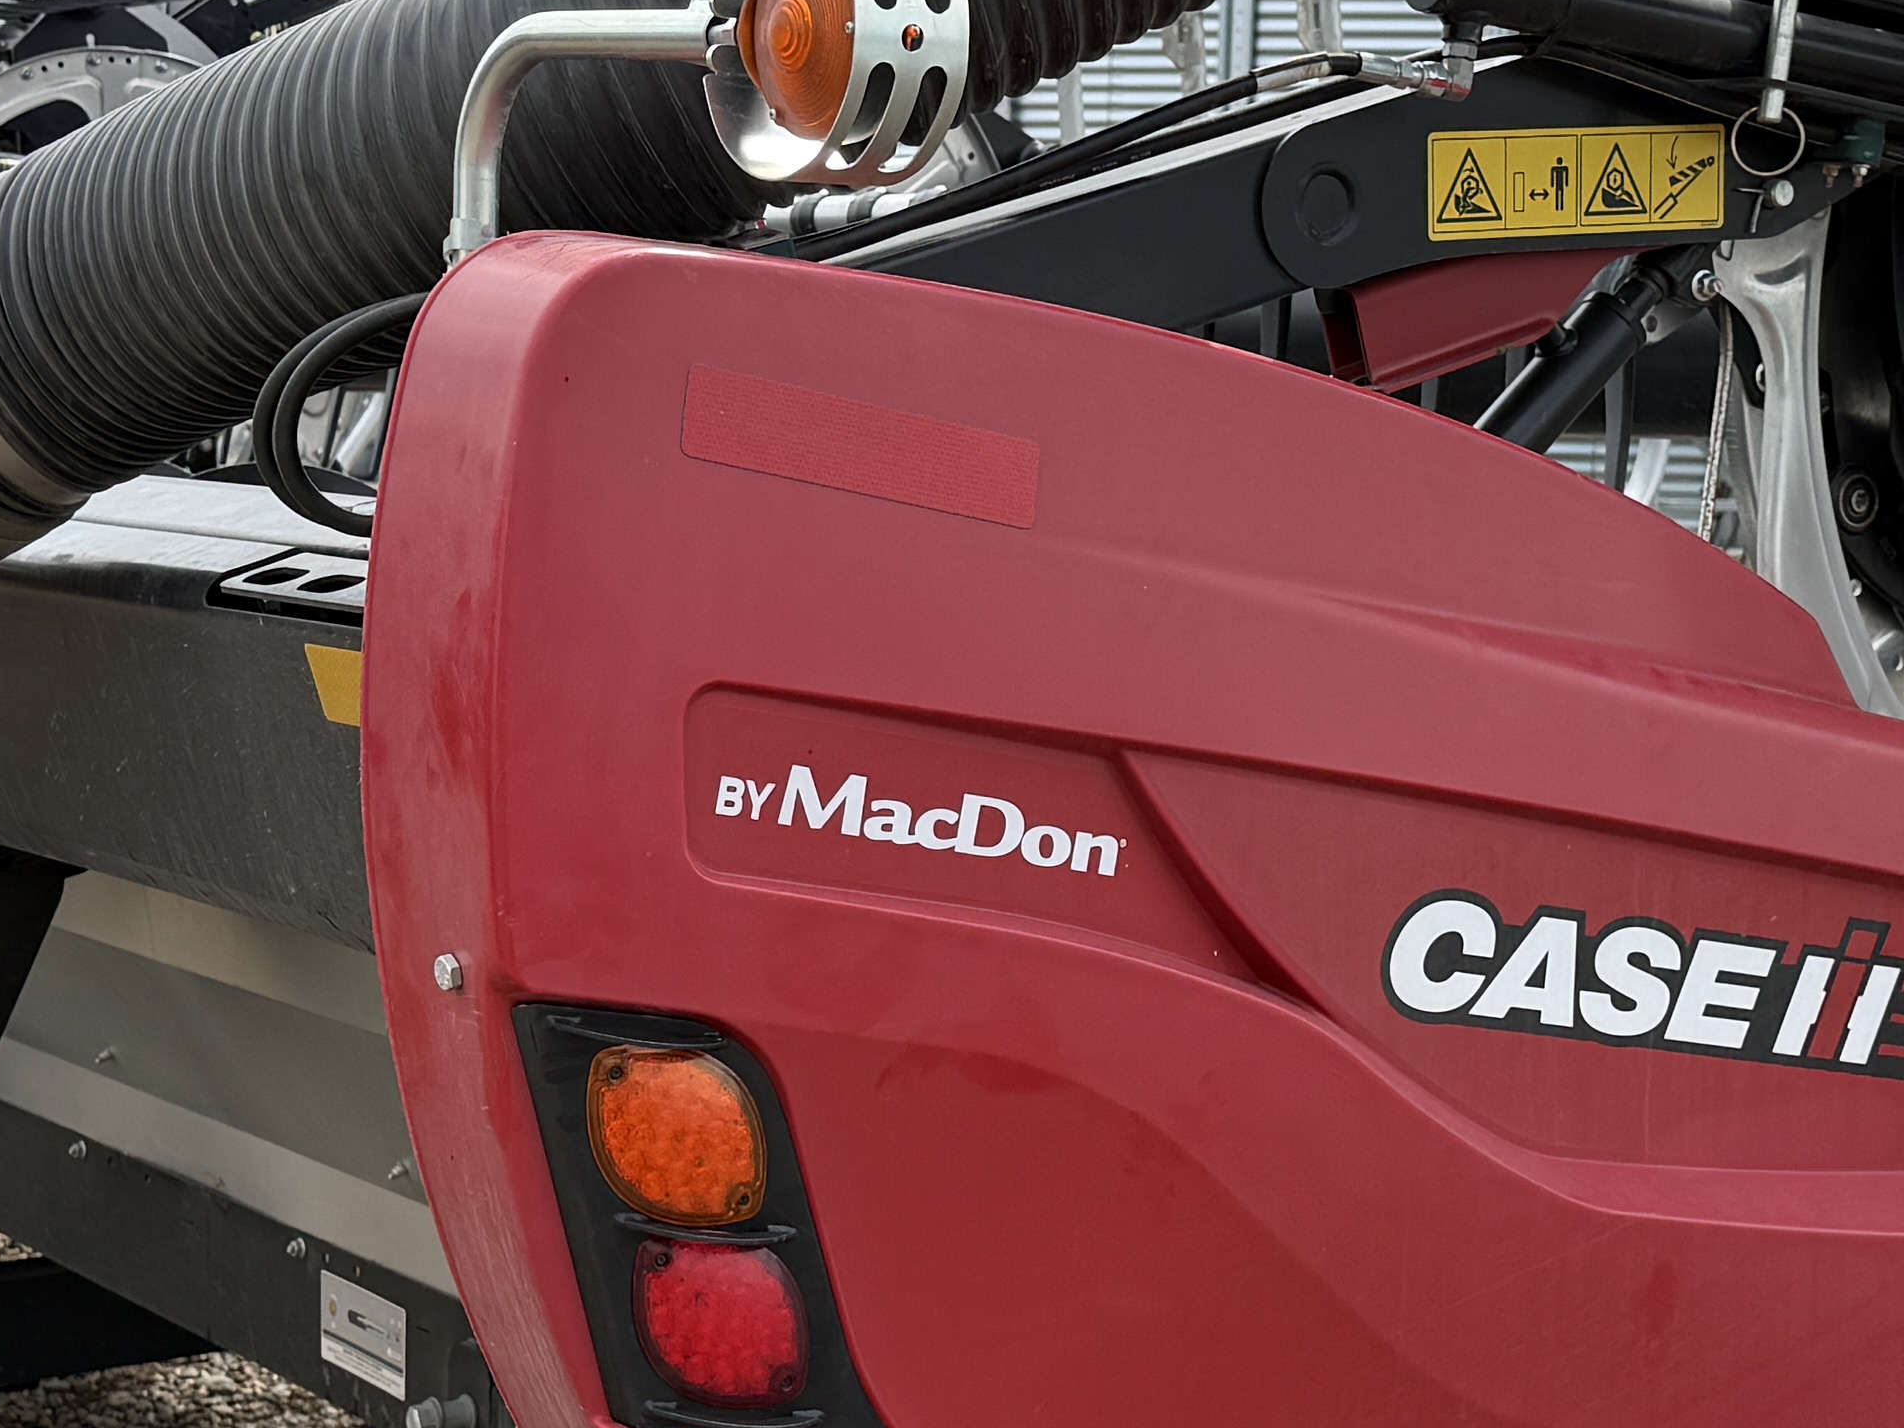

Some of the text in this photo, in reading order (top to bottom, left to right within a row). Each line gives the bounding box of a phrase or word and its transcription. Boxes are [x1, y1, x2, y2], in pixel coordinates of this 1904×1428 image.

[715, 764, 1120, 877] BY MacDon
[1388, 898, 1778, 1050] CASE
